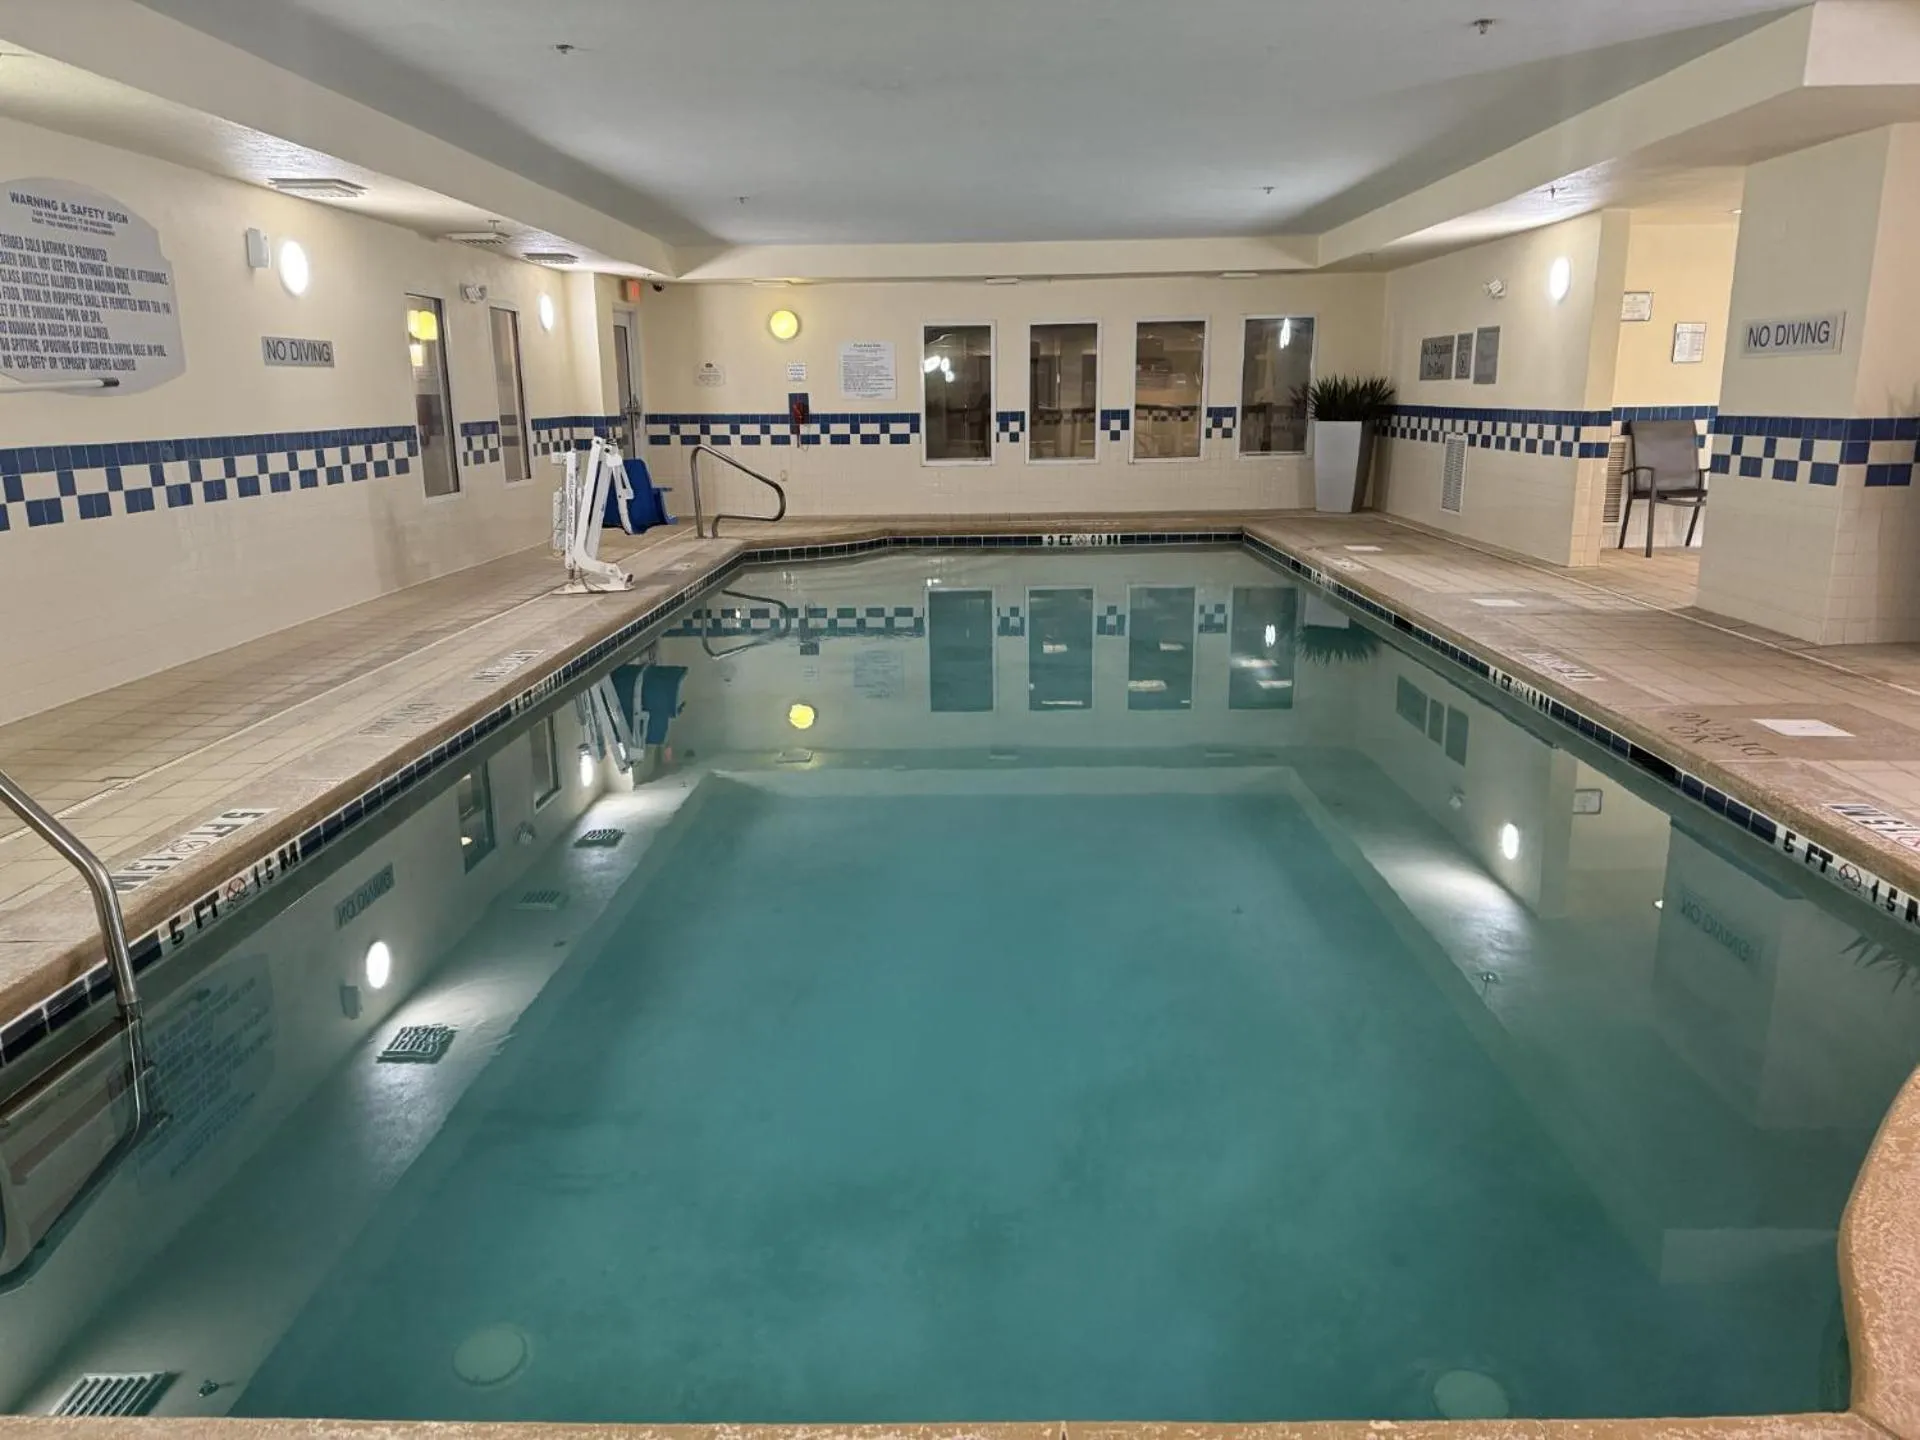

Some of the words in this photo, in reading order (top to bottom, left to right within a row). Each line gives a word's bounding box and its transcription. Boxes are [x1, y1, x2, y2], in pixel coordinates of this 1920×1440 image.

[9, 191, 58, 211] WARNING
[61, 202, 68, 213] &
[70, 204, 104, 219] SAFETY
[107, 211, 128, 224] SIGN
[1748, 325, 1770, 348] NO
[1775, 320, 1830, 346] DIVING
[266, 340, 286, 361] NO
[290, 341, 331, 362] DIVING
[1783, 830, 1797, 853] 5
[1805, 842, 1834, 874] FT
[168, 917, 185, 945] 5
[192, 891, 220, 930] FT
[278, 842, 300, 872] M
